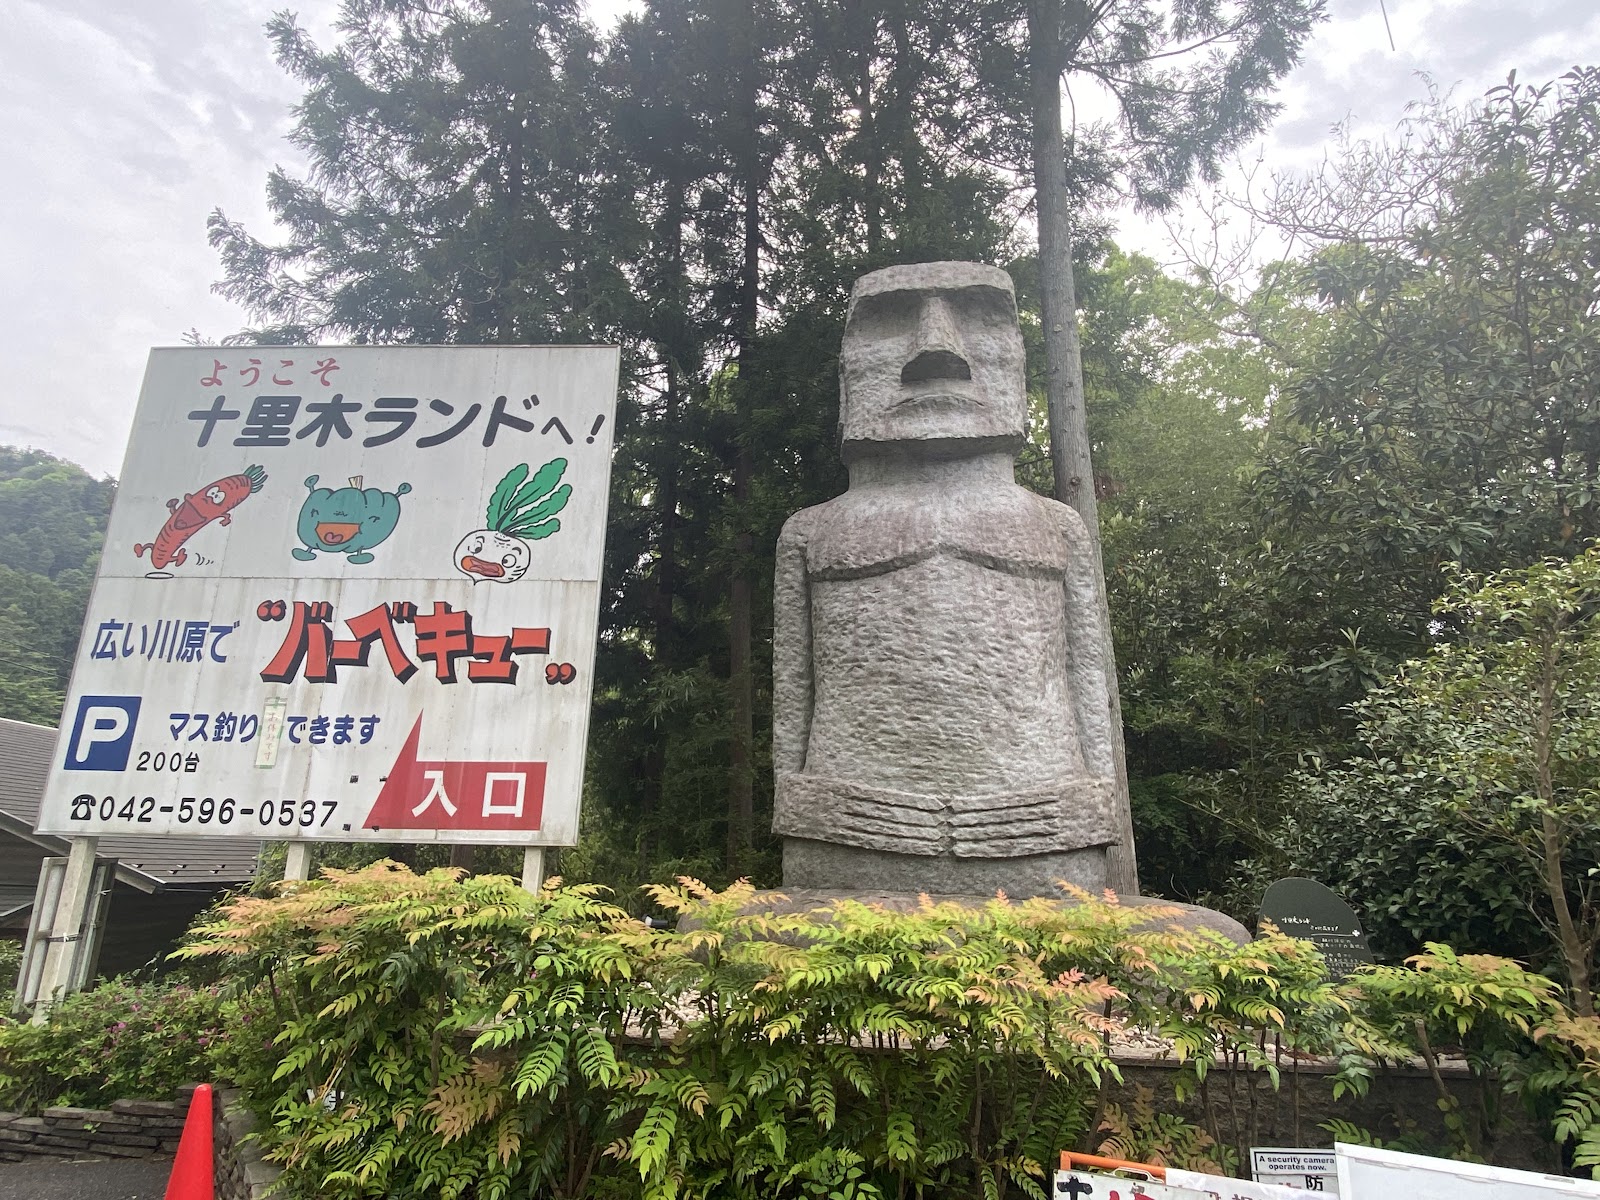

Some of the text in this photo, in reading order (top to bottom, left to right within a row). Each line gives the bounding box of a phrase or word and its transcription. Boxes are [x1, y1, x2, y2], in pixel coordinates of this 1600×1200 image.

[201, 357, 340, 388] ようこそ
[91, 620, 239, 663] 広い川原で
[169, 713, 380, 745] マス釣り できます
[137, 751, 200, 773] 200台
[412, 770, 527, 817] 入口
[100, 796, 338, 828] 042-596-0537
[1267, 1156, 1301, 1164] security
